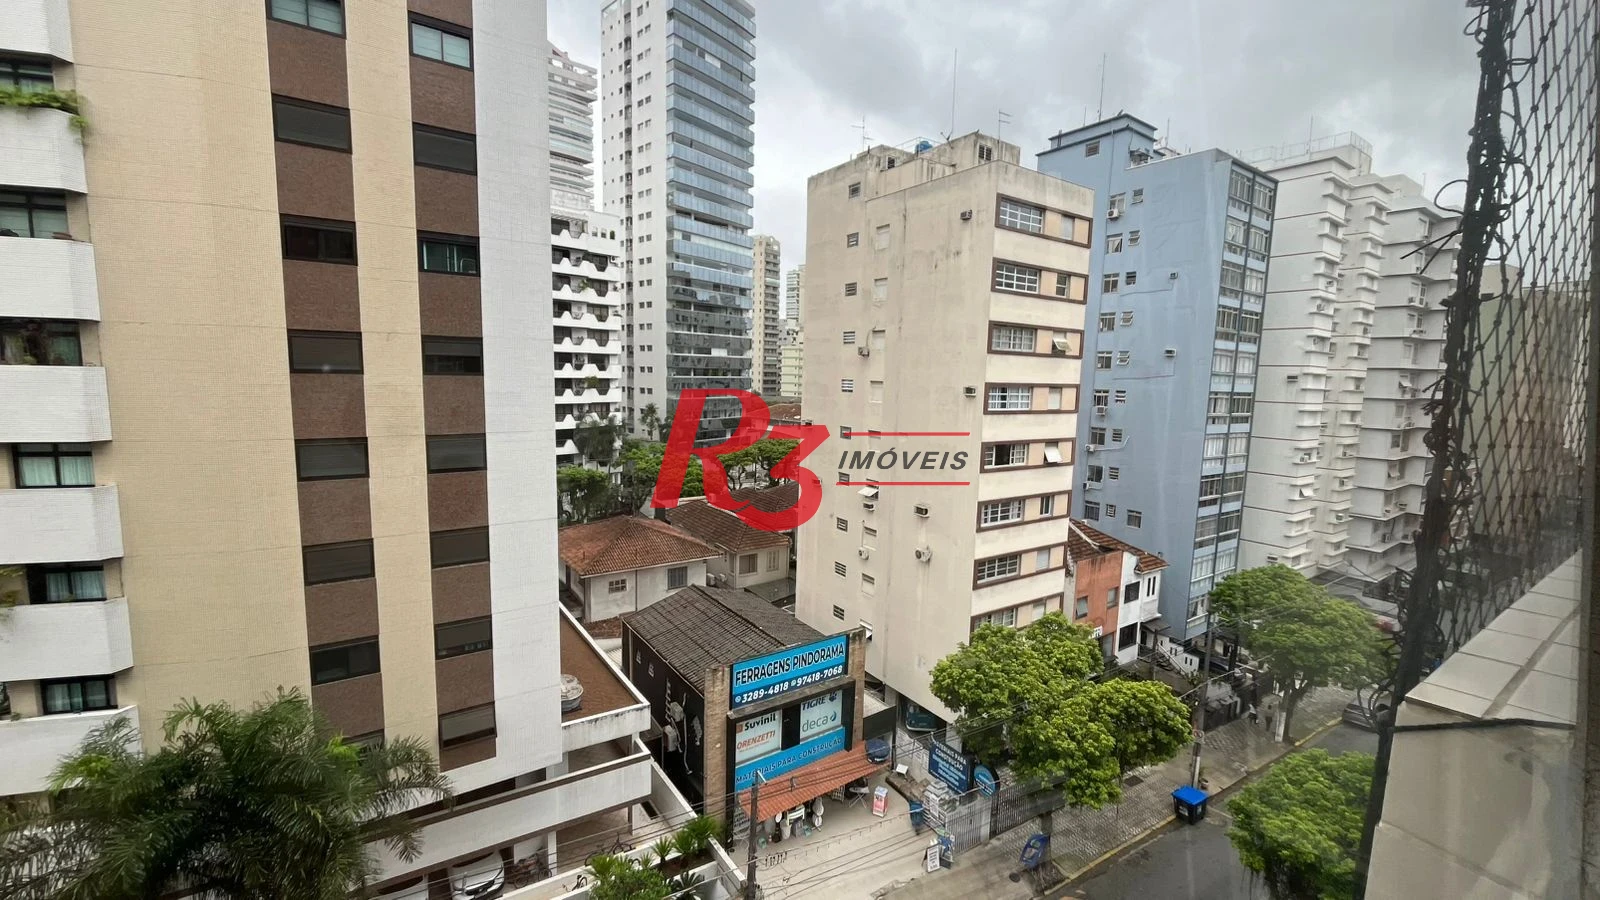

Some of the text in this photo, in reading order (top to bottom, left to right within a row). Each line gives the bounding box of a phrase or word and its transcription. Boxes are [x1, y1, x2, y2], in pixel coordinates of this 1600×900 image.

[735, 642, 845, 687] FERRAGENS PINDORAMA
[741, 665, 843, 703] 3289-4818 97418-7068
[801, 697, 826, 711] TIGRE
[744, 712, 776, 731] Suvinil
[801, 714, 828, 732] deca
[736, 730, 776, 750] ORENZETTI
[777, 755, 797, 771] PARA
